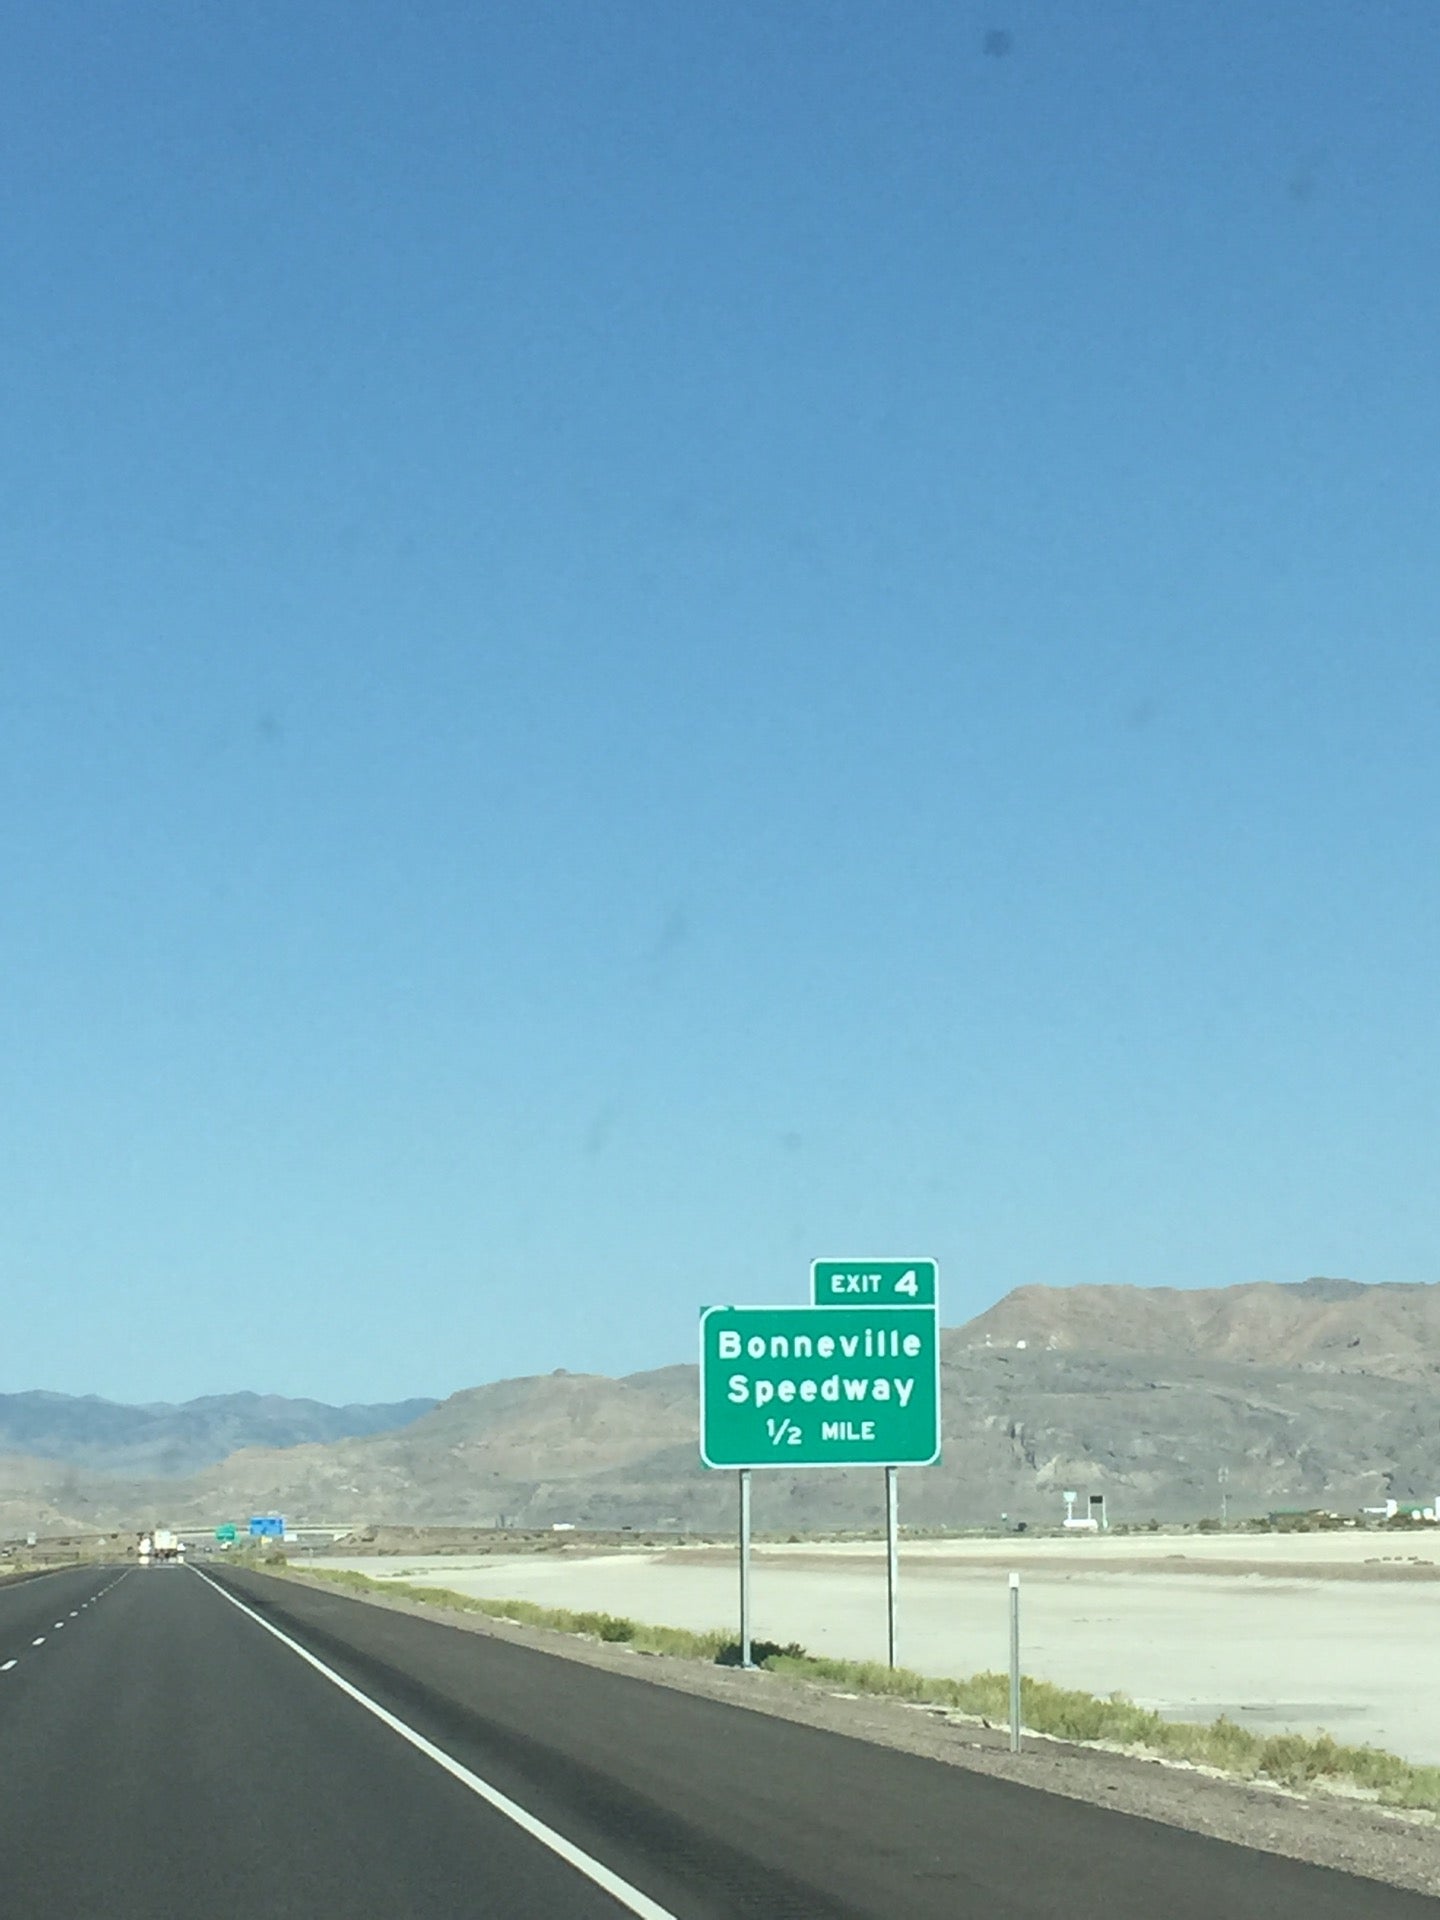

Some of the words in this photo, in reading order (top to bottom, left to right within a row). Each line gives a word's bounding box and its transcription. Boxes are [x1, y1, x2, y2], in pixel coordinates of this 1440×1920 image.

[831, 1274, 881, 1293] EXIT
[894, 1270, 918, 1296] 4
[718, 1328, 921, 1359] Bonneville
[727, 1374, 914, 1407] Speedway
[822, 1421, 875, 1440] MILE
